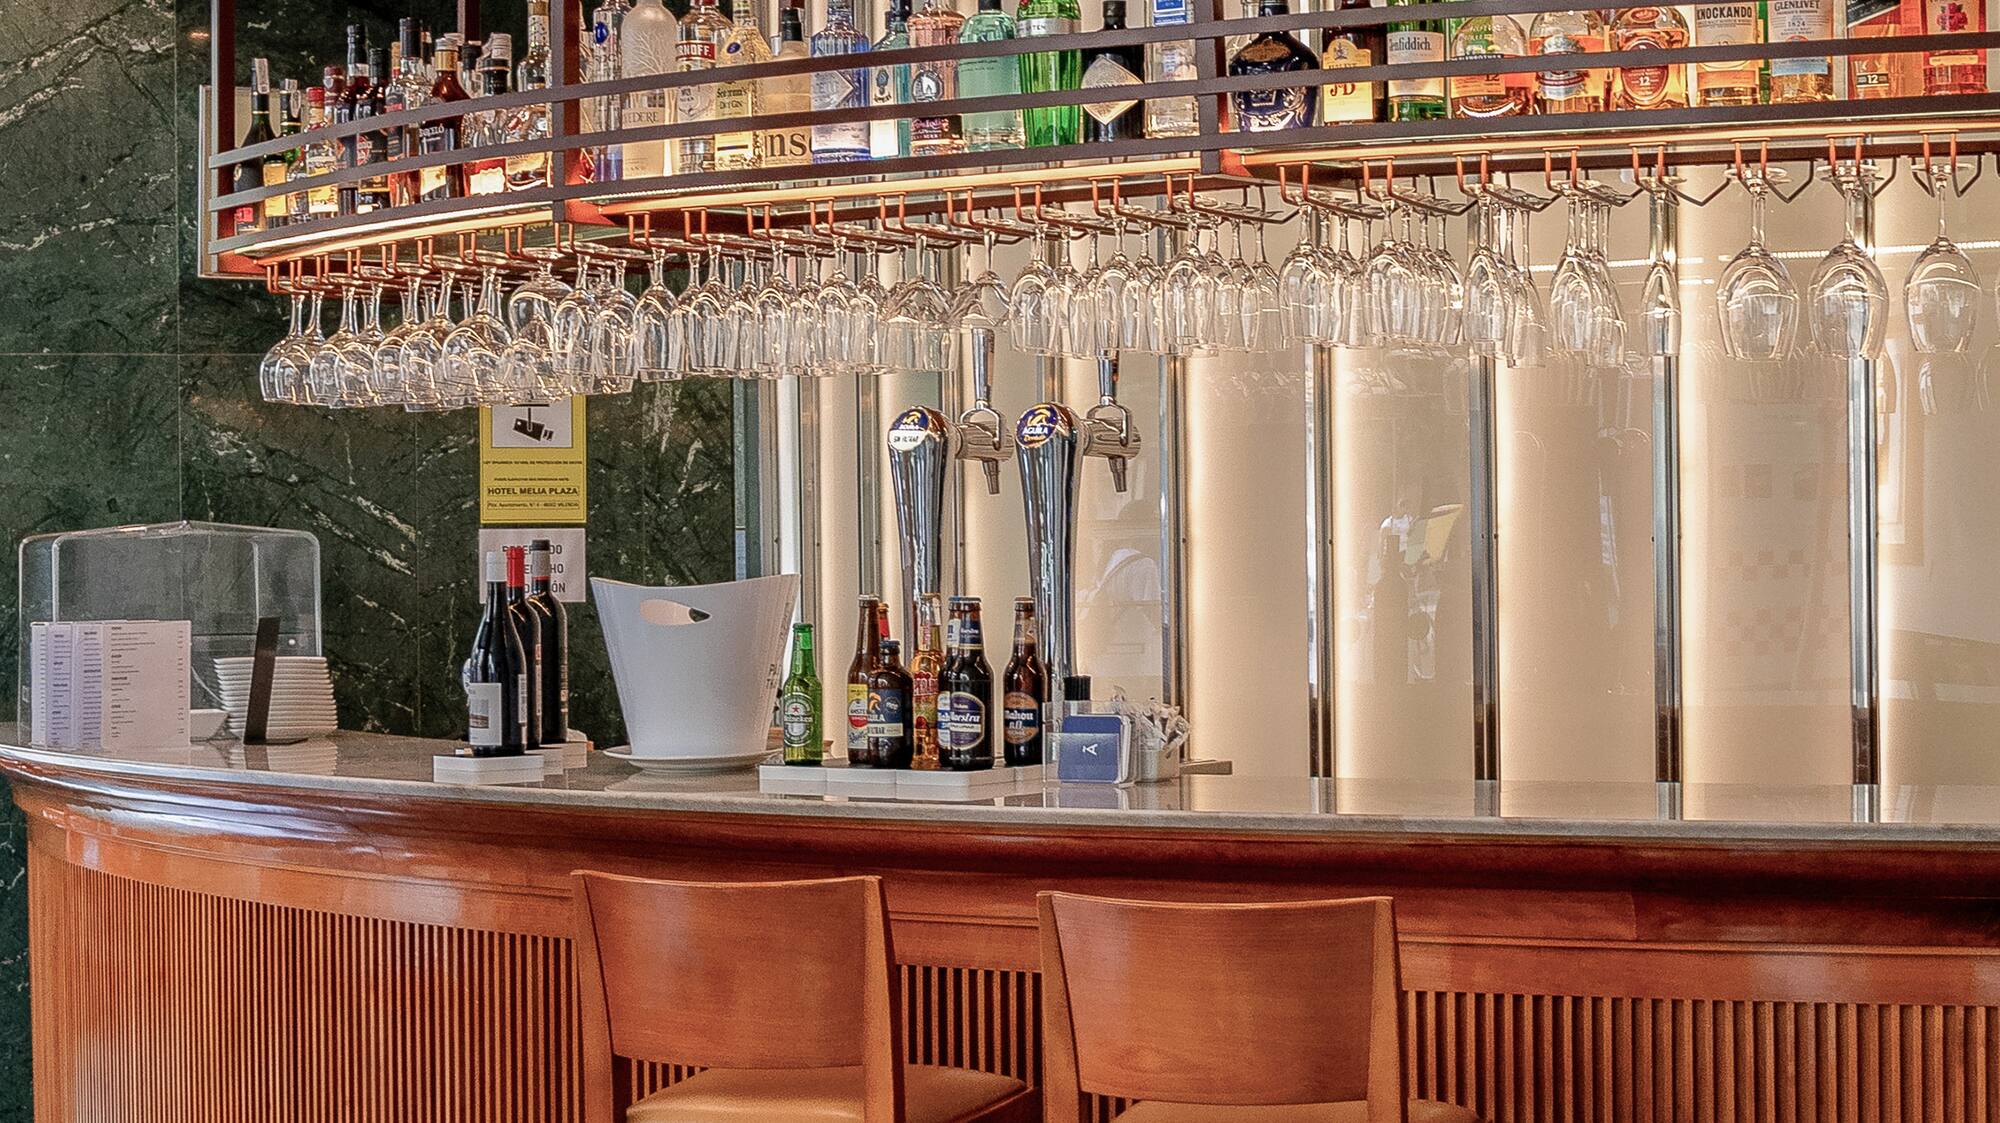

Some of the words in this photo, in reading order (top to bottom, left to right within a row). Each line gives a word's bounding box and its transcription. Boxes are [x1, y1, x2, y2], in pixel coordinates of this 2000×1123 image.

[1774, 0, 1820, 11] GLENLIVET
[677, 44, 712, 56] RNOFF.
[1639, 76, 1651, 86] 12
[1867, 75, 1878, 83] 12
[488, 487, 517, 495] HOTEL
[519, 487, 547, 495] MELIA
[549, 487, 578, 495] PLAZA
